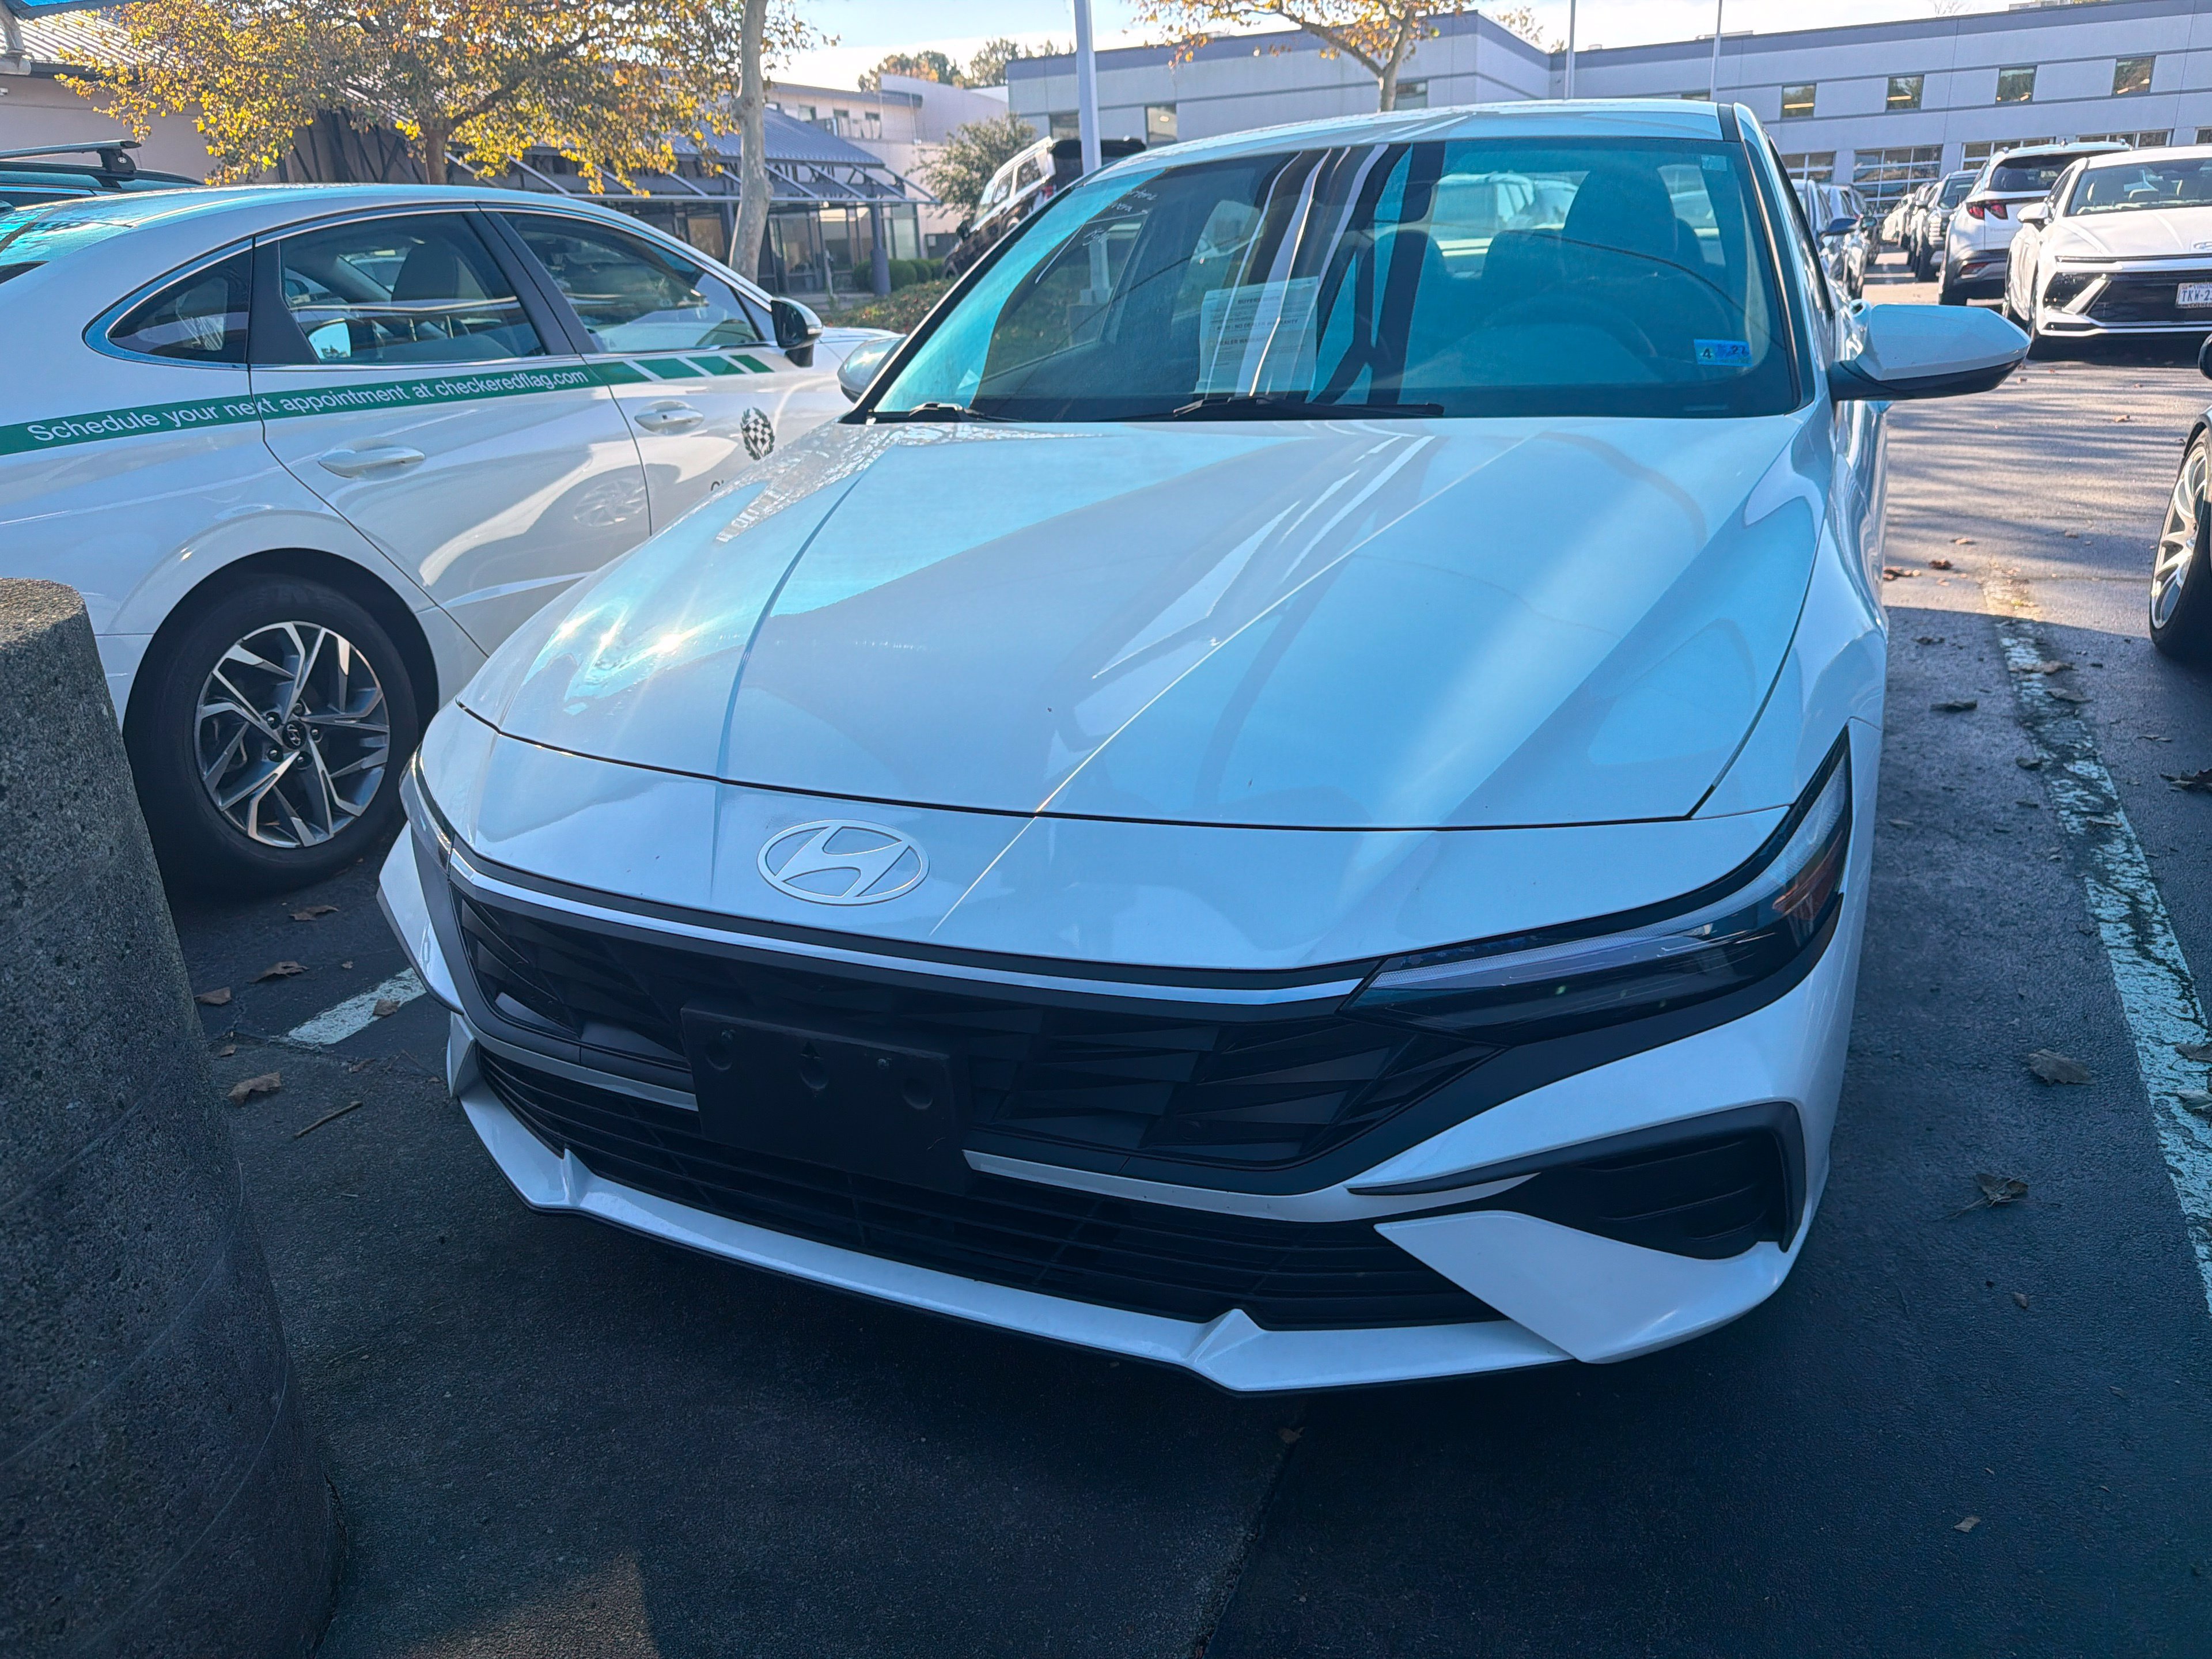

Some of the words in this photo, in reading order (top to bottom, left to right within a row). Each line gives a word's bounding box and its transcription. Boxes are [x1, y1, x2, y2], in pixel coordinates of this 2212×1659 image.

[2182, 289, 2212, 302] TKW-2
[27, 411, 160, 441] Schedule
[162, 406, 218, 427] your
[224, 397, 278, 416] next
[279, 385, 411, 412] appointment
[412, 382, 434, 399] at
[435, 370, 589, 396] checkeredflag.com
